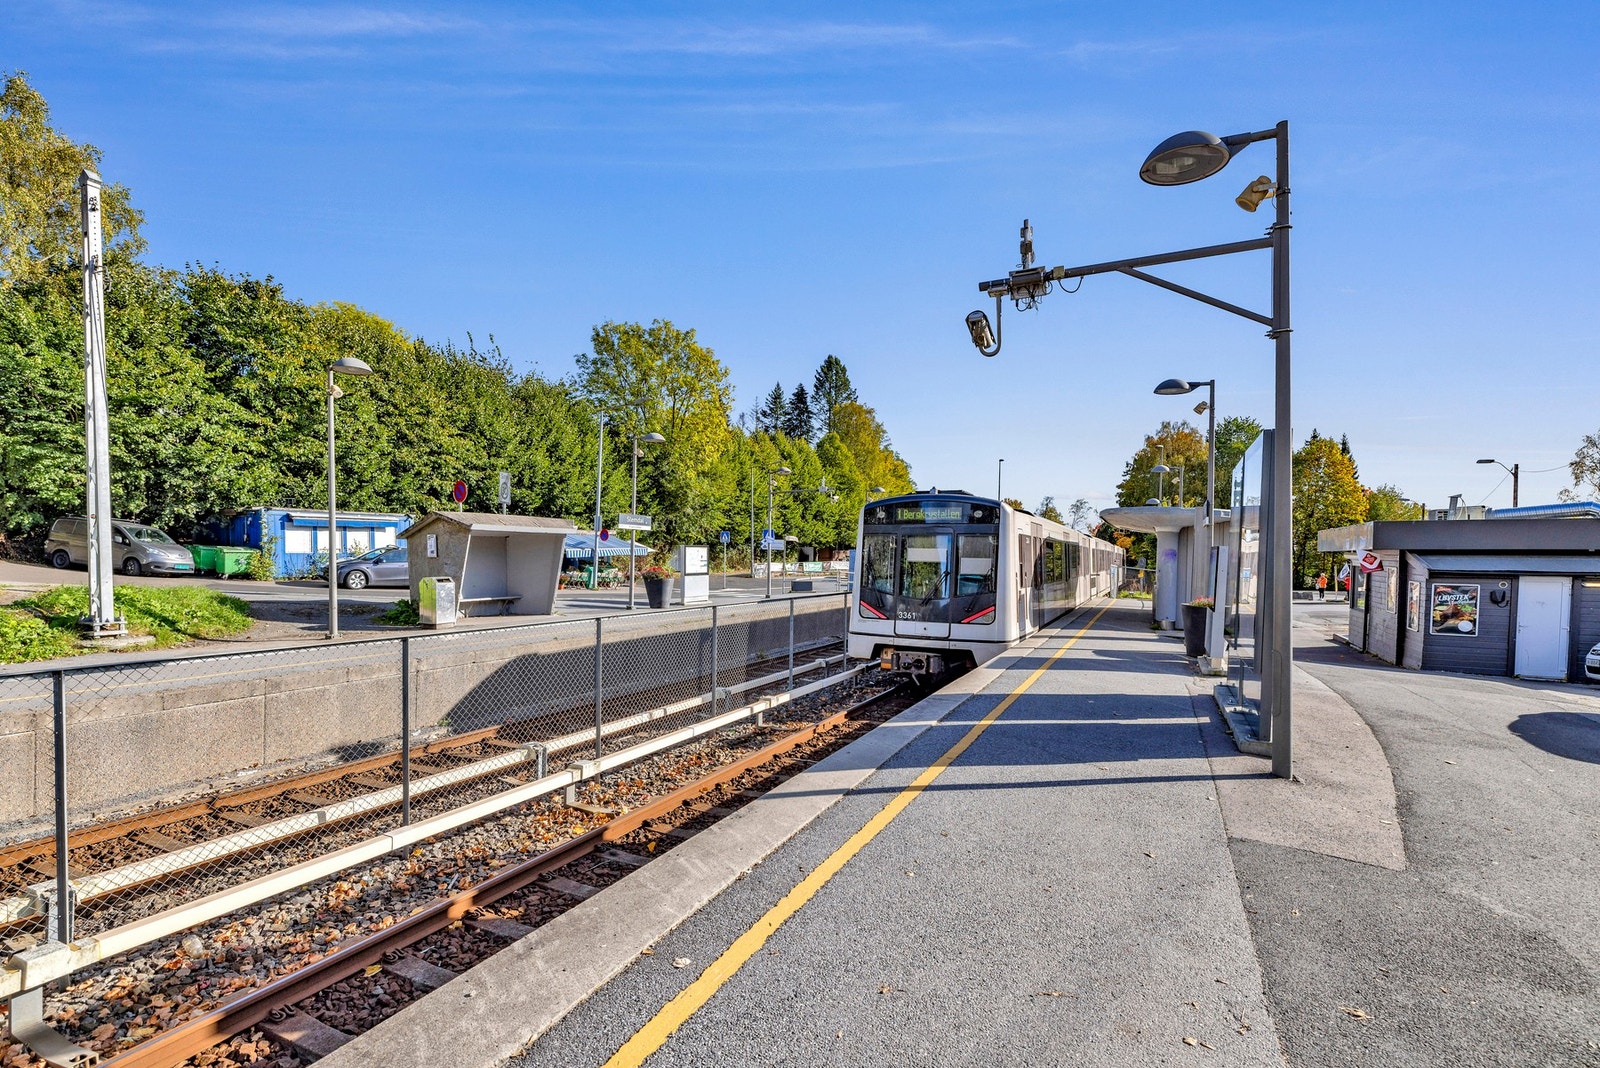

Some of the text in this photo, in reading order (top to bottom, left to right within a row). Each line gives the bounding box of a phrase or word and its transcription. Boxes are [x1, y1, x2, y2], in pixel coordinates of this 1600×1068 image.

[897, 508, 961, 520] 1 Bergkrystallen
[898, 611, 916, 620] 3361
